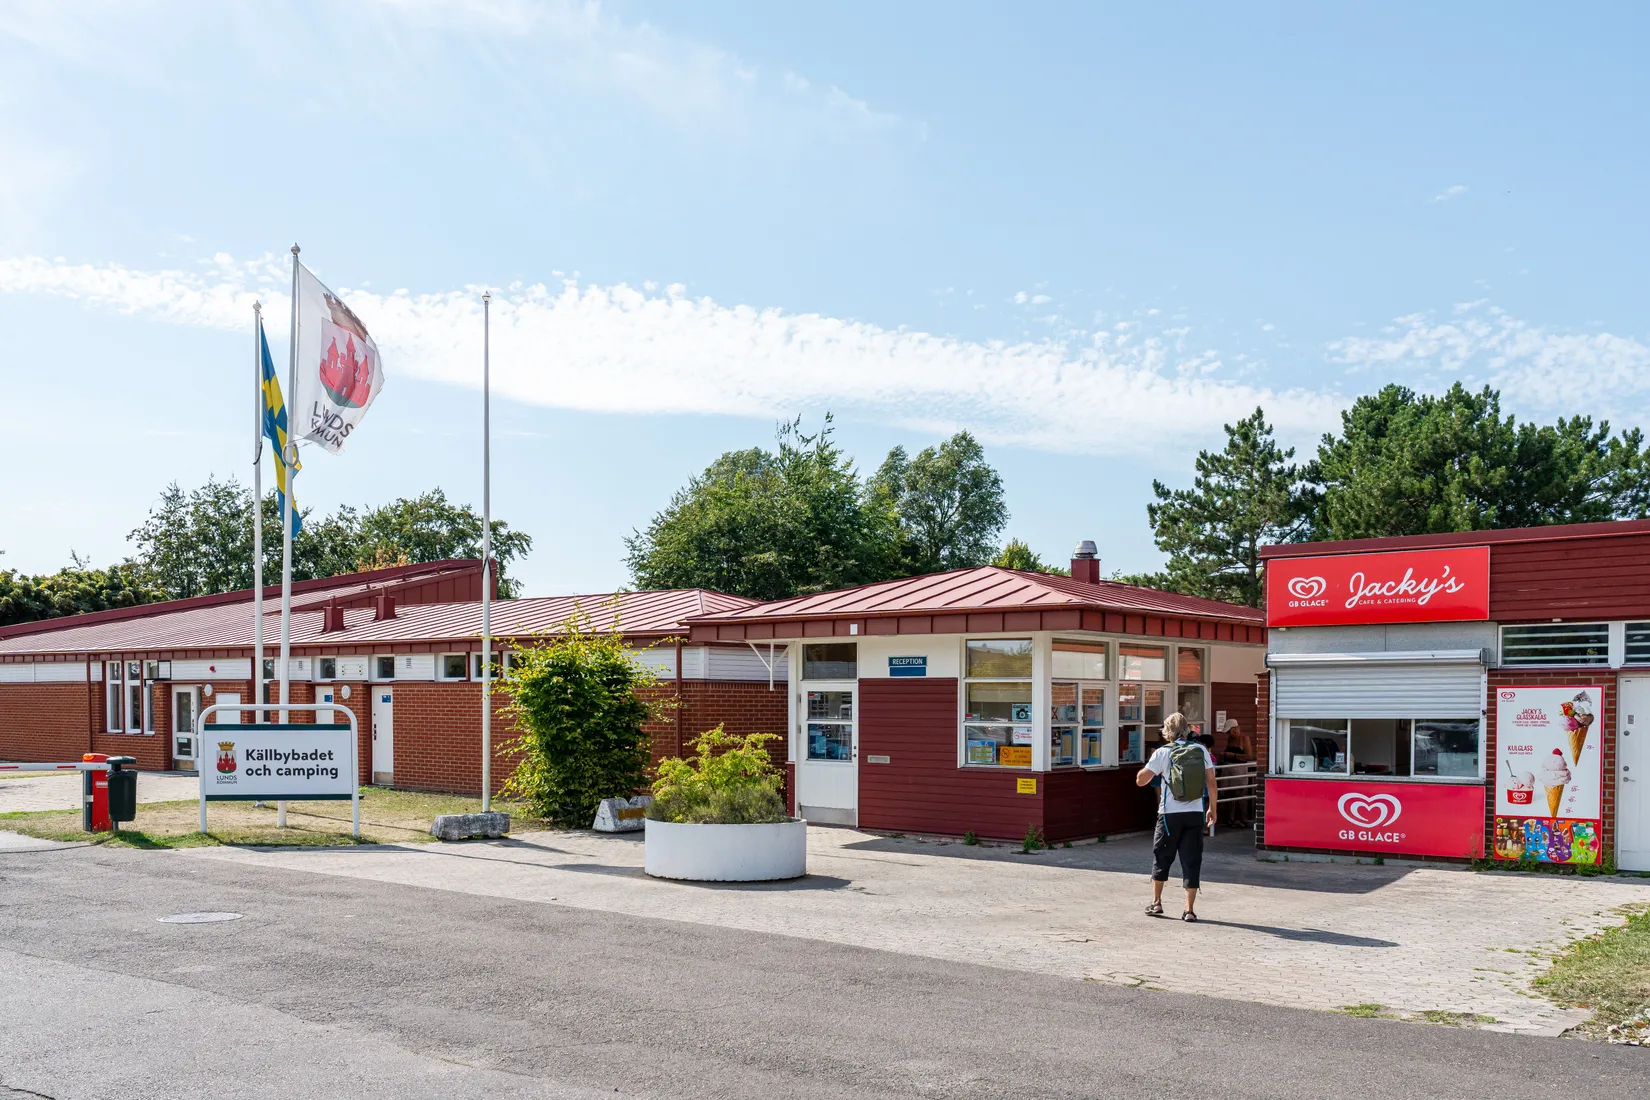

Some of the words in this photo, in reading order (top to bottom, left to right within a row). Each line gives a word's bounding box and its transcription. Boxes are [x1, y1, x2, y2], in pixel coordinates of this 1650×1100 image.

[1345, 565, 1465, 609] Jacky's
[1288, 600, 1299, 608] GB
[245, 748, 334, 764] Källbybadet
[245, 764, 271, 776] och
[276, 764, 339, 779] camping
[1338, 830, 1355, 840] GB
